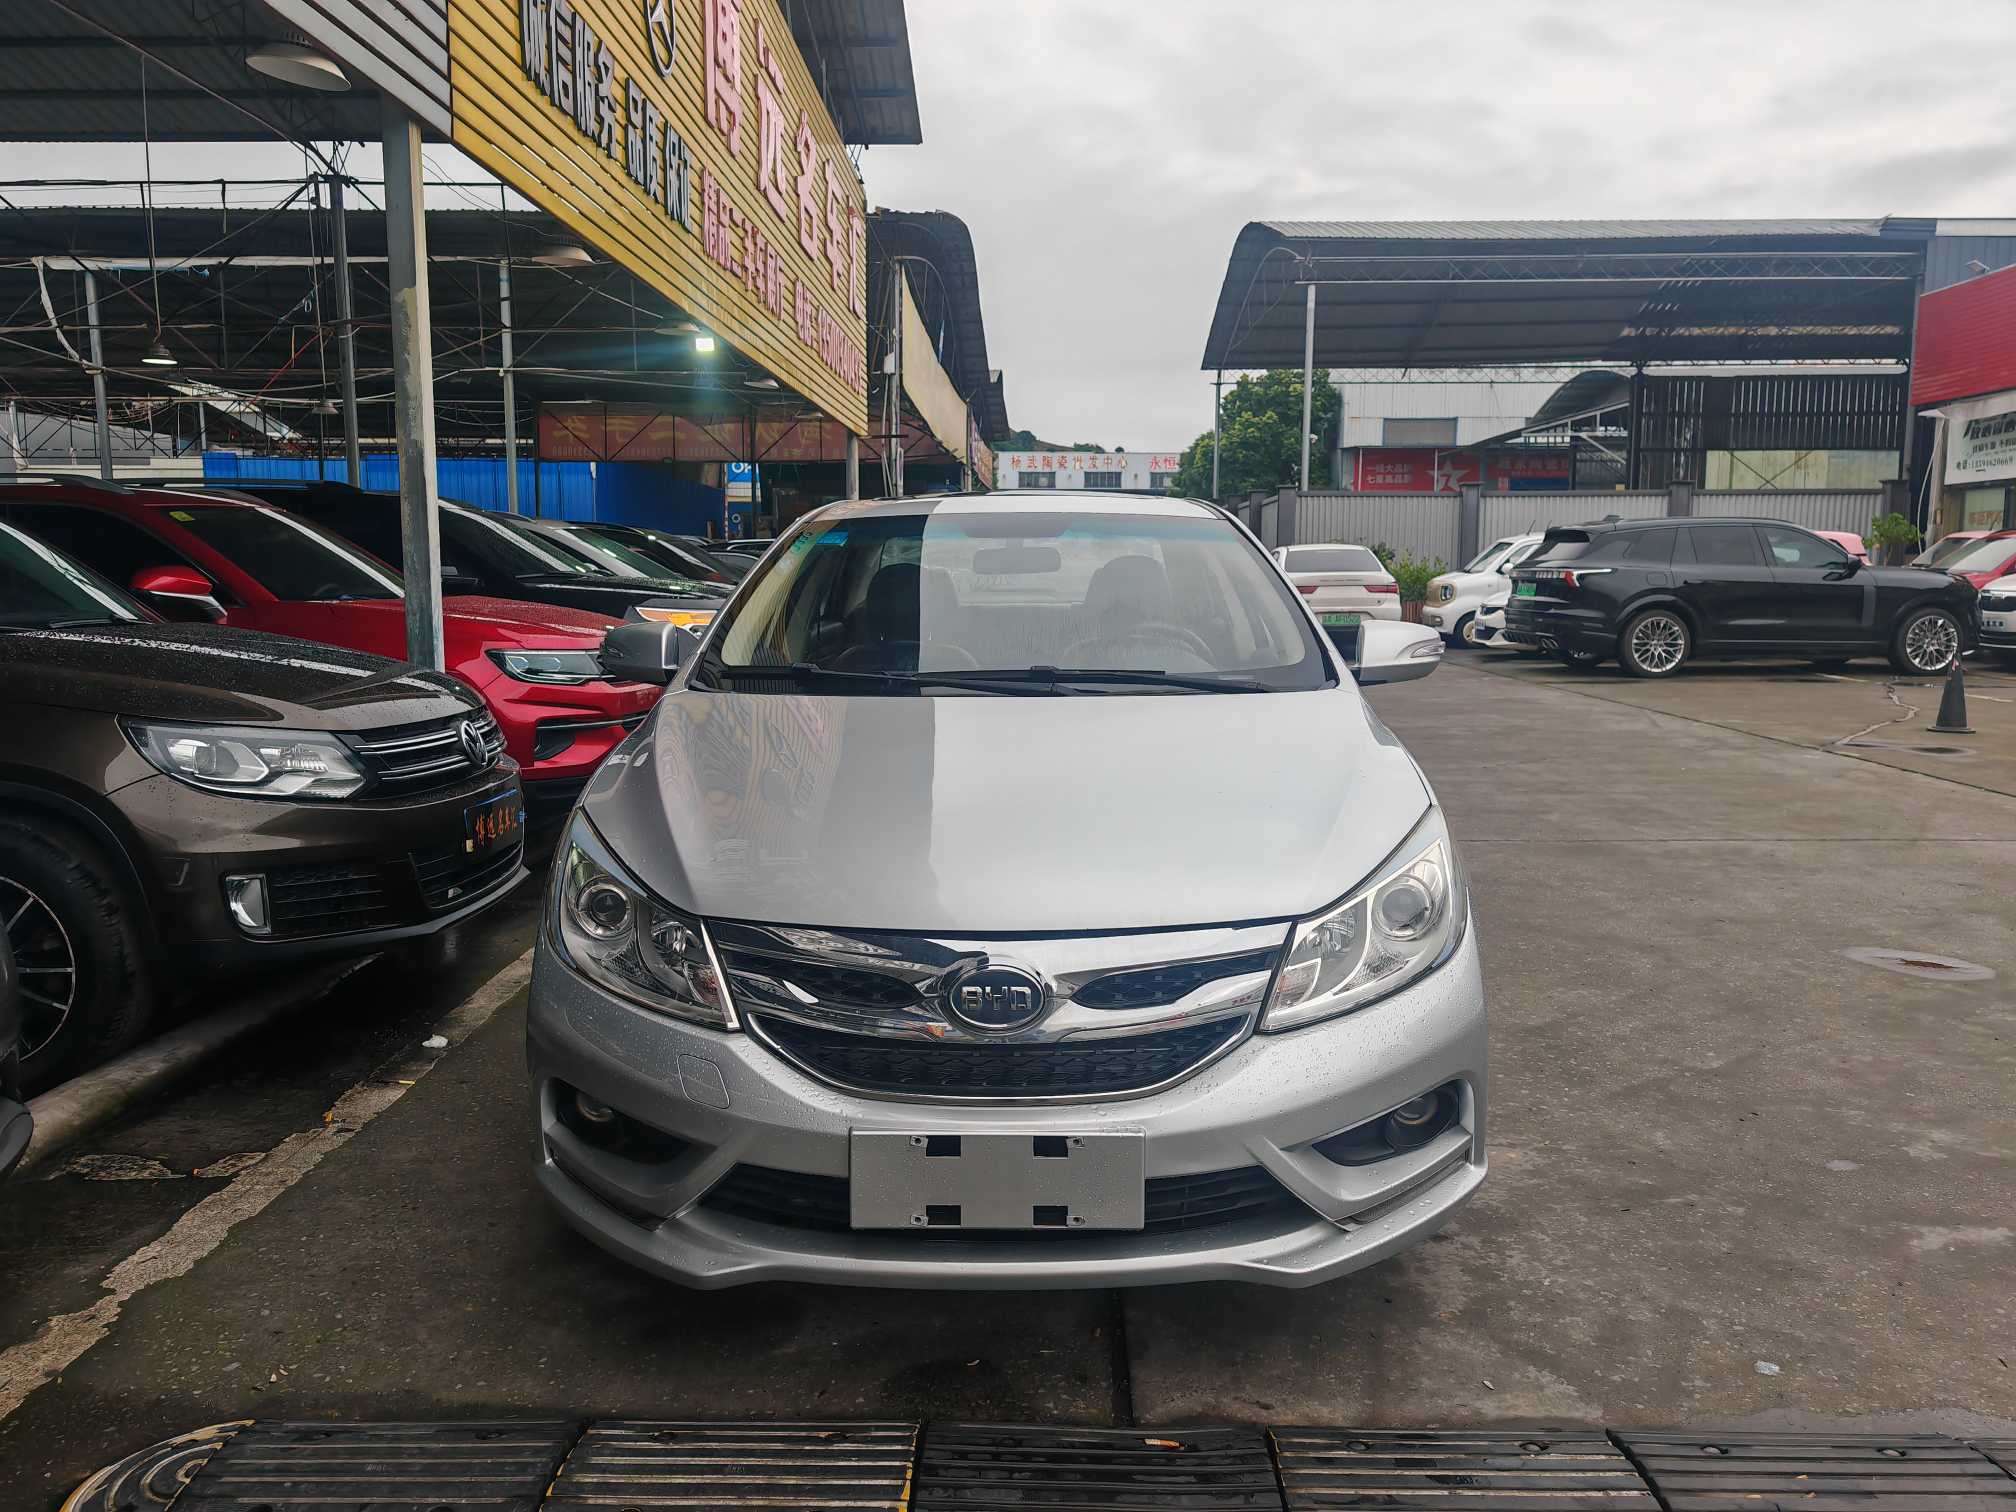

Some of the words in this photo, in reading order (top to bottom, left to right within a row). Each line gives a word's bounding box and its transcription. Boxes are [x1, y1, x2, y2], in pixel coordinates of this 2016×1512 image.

[520, 0, 617, 160] 诚信服务
[961, 986, 1032, 1011] BYD
